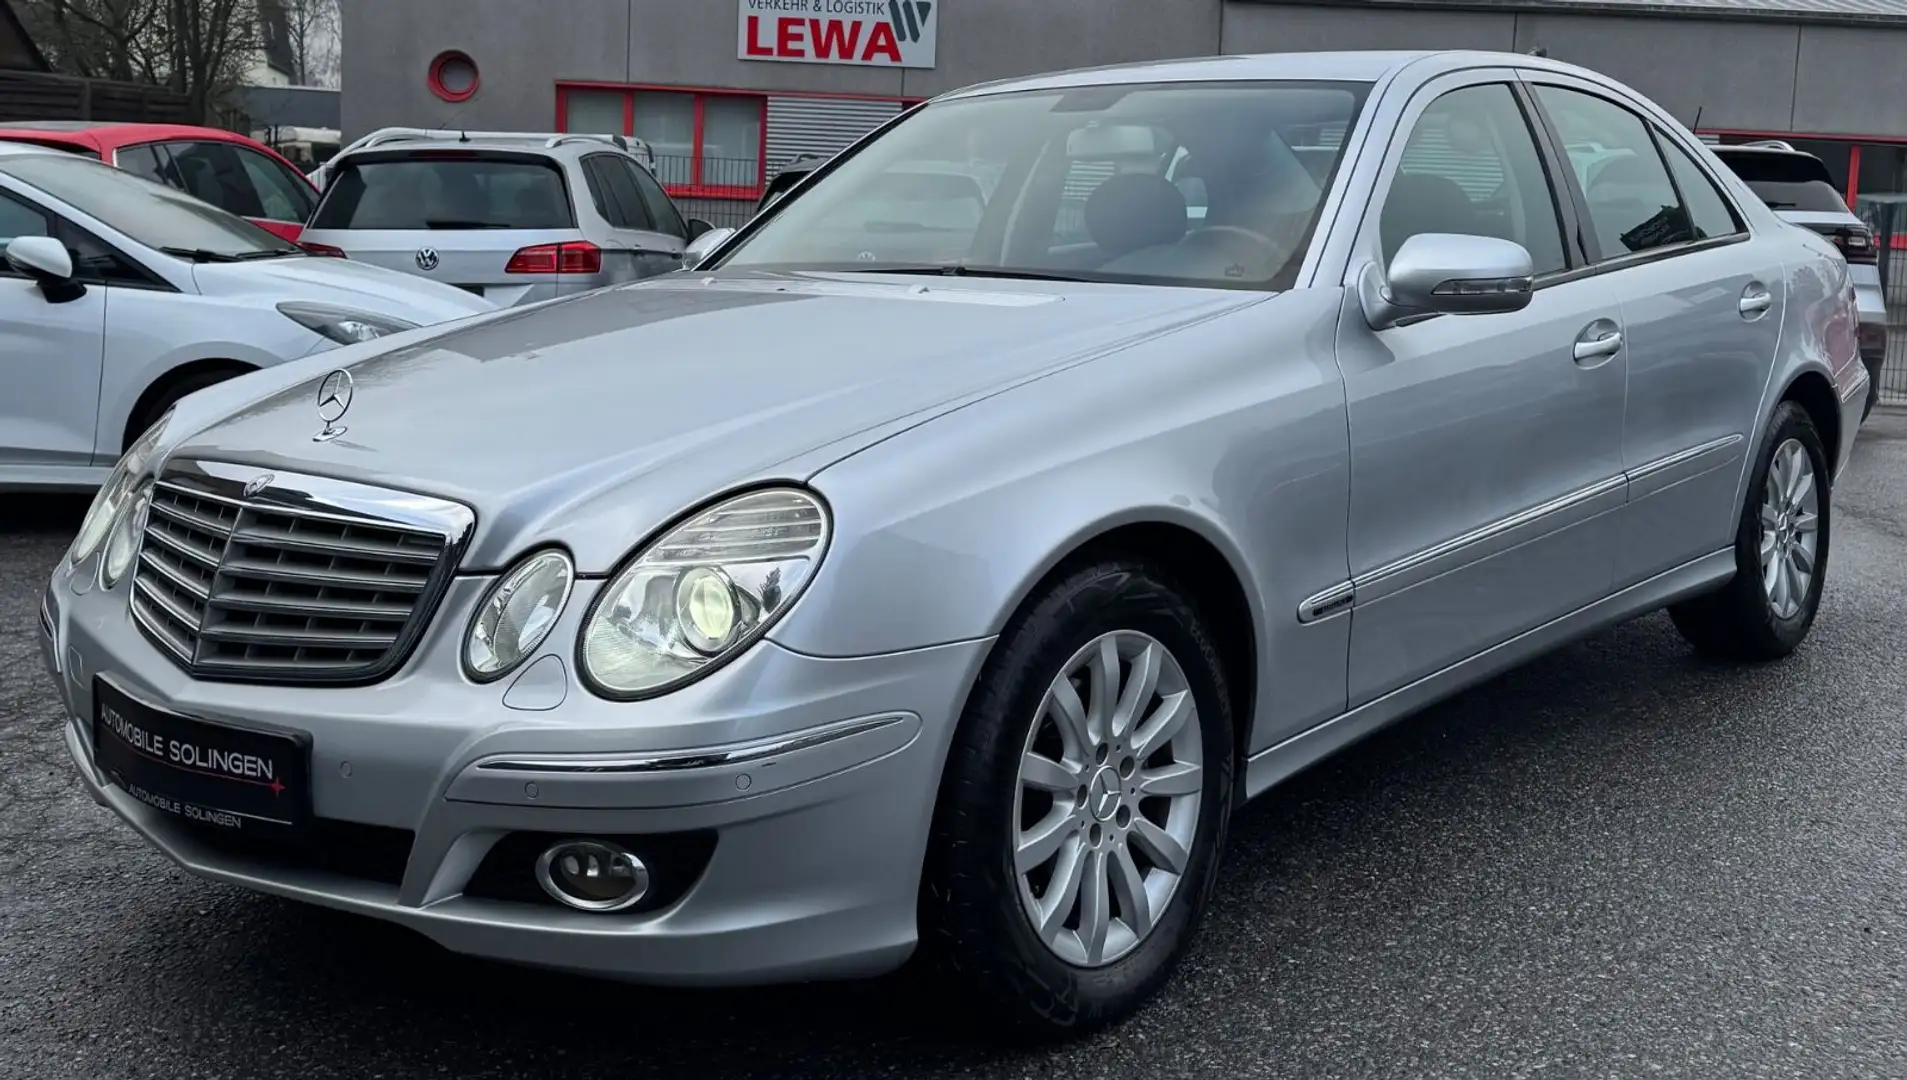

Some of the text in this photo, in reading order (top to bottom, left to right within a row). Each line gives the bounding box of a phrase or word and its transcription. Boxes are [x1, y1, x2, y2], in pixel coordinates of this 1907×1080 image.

[748, 0, 885, 15] VERKEHR & LOGISTIK
[747, 15, 902, 62] LEWA
[100, 703, 274, 780] AUTOMOBILE SOLINGEN
[128, 784, 242, 829] AUTOMOBILE SOLINGEN
